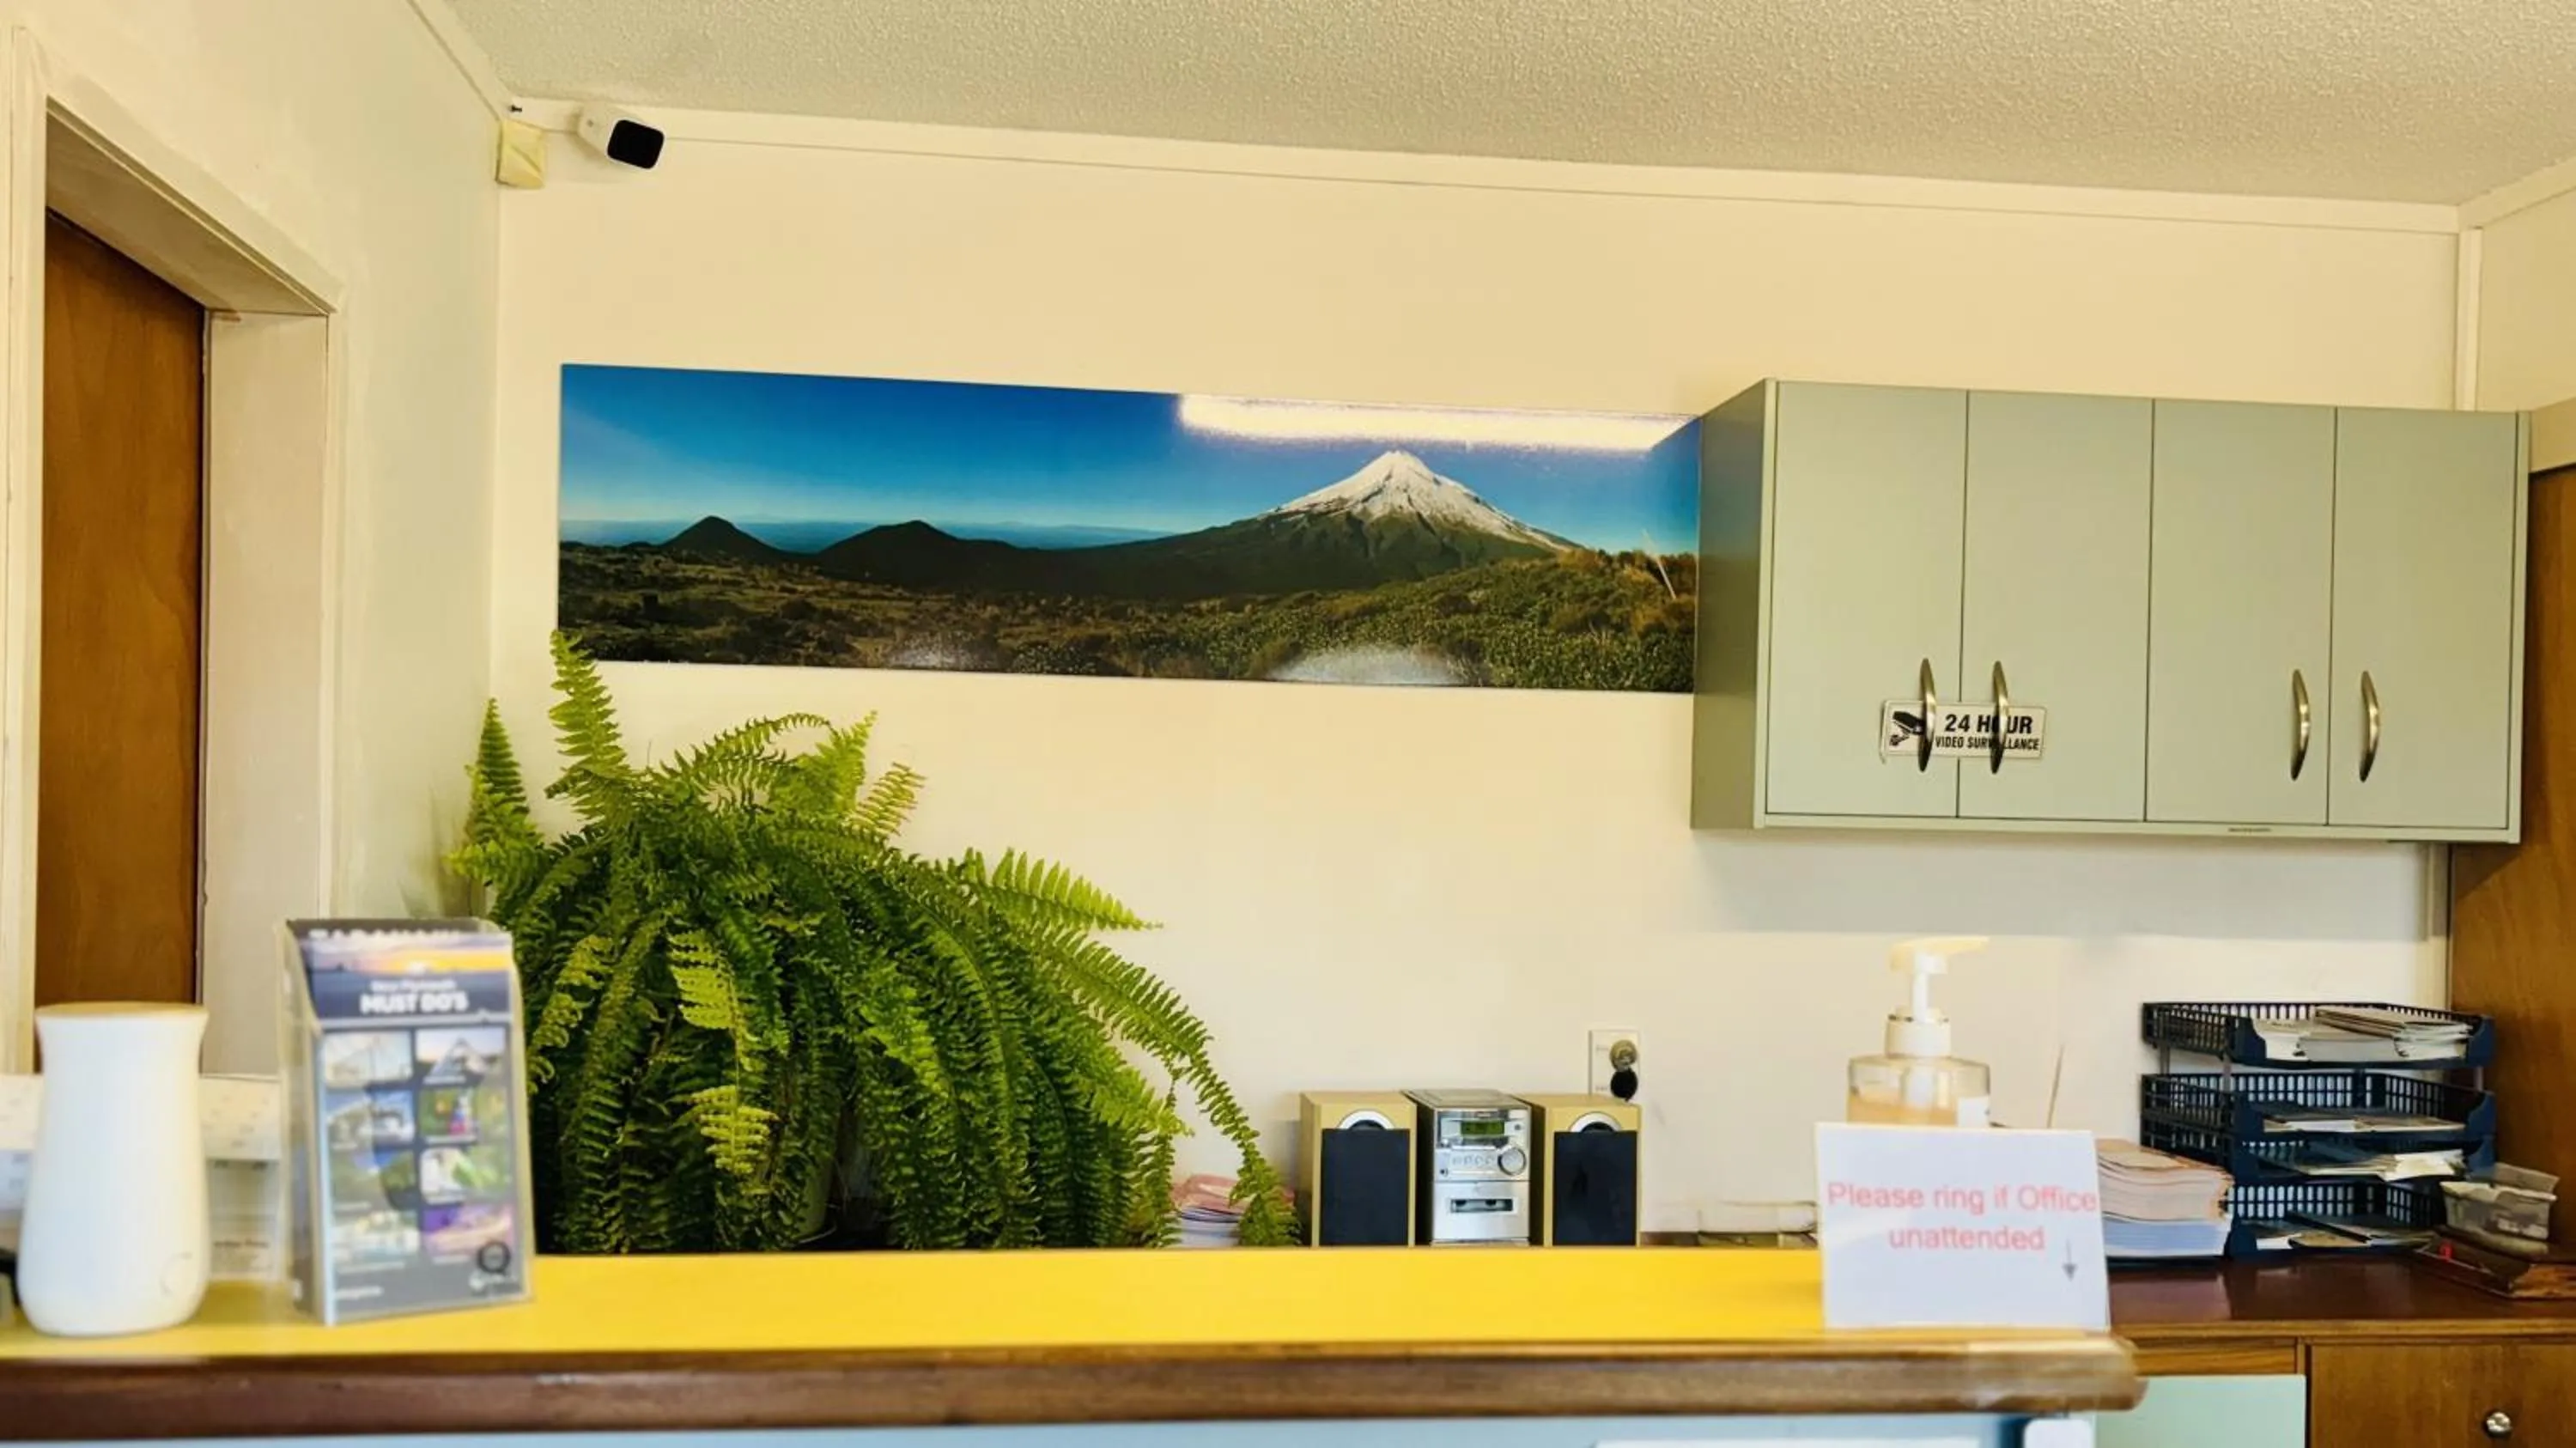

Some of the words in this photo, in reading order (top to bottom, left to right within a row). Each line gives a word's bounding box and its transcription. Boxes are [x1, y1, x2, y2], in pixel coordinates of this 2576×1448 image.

[1944, 714, 1971, 733] 24
[1935, 736, 1965, 748] VIDEO
[1967, 737, 2039, 750] SURVLLANCE
[360, 993, 418, 1014] MUST
[1827, 1182, 1924, 1208] Please
[1934, 1183, 1984, 1215] ring
[1994, 1183, 2012, 1210] if
[2018, 1183, 2098, 1212] Office
[1889, 1226, 2044, 1250] unattended
